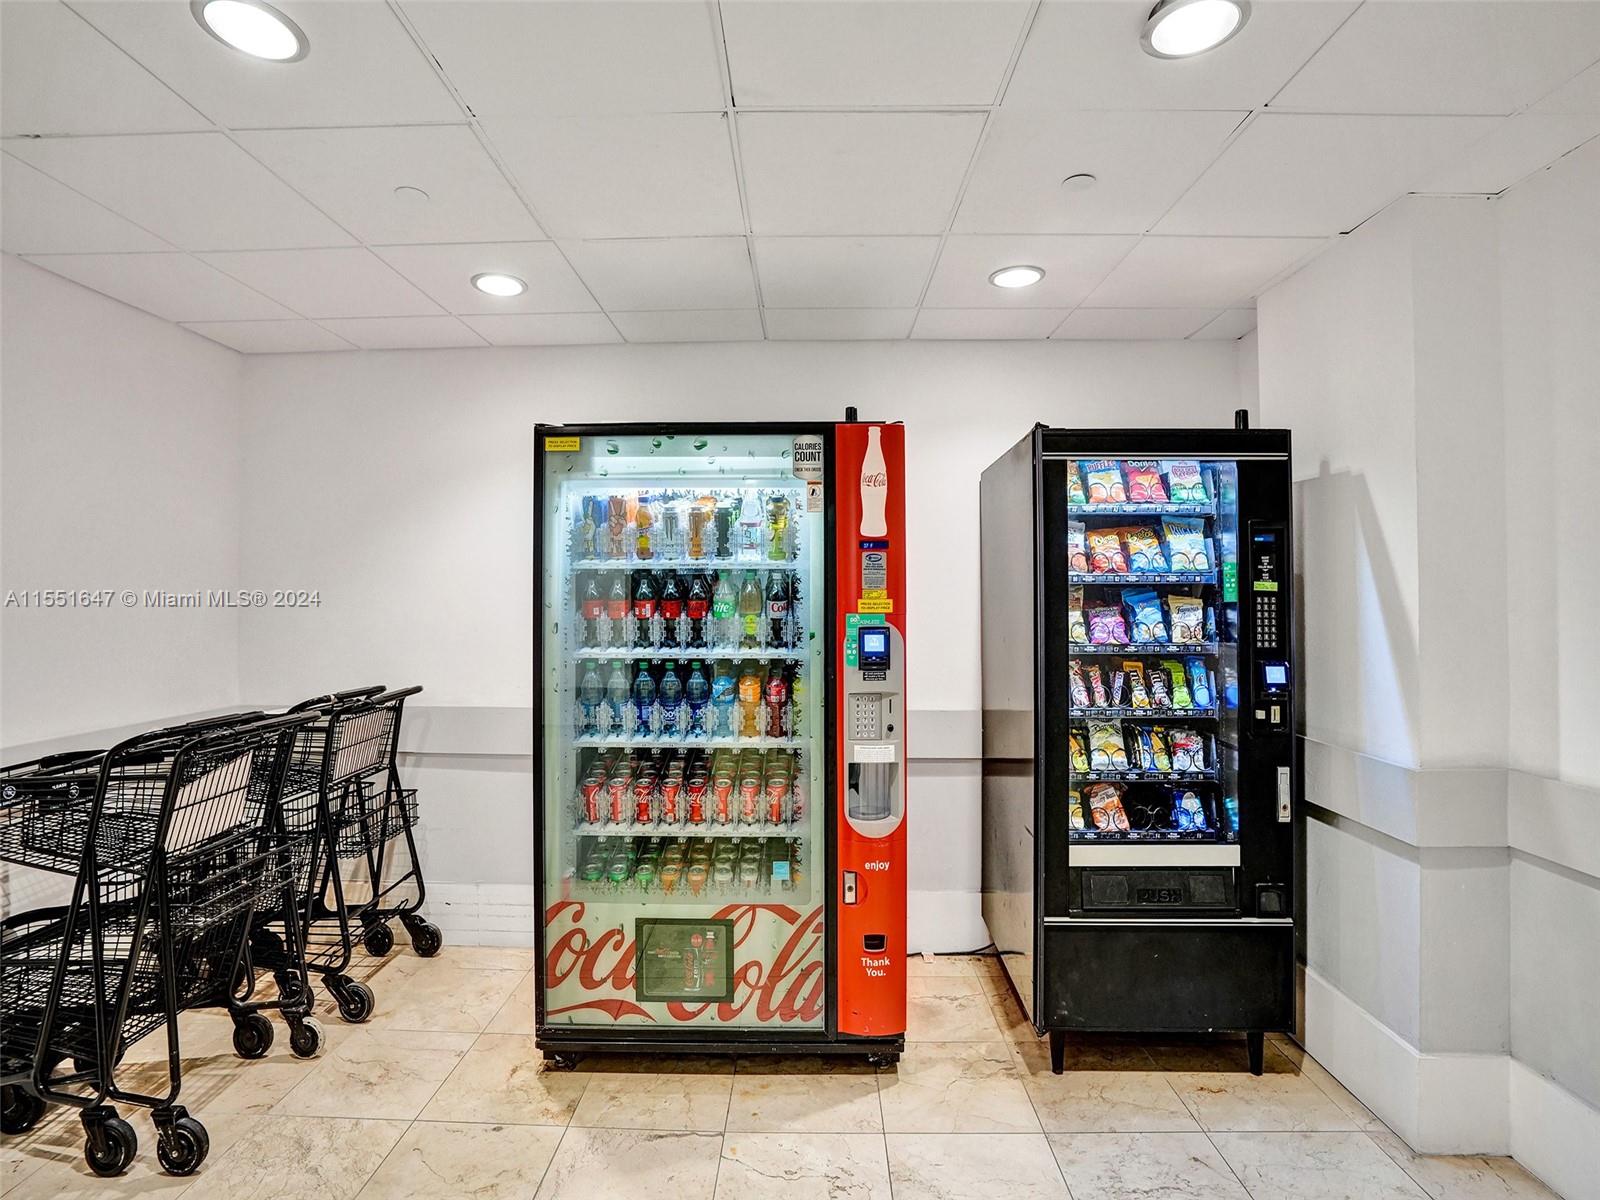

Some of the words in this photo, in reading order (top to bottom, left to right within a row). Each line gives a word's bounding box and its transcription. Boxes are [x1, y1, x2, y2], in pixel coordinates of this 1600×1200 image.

[794, 442, 822, 451] CALORIES
[794, 451, 822, 462] COUNT
[864, 861, 890, 871] enjoy
[861, 957, 891, 966] Thank
[866, 968, 886, 976] You.
